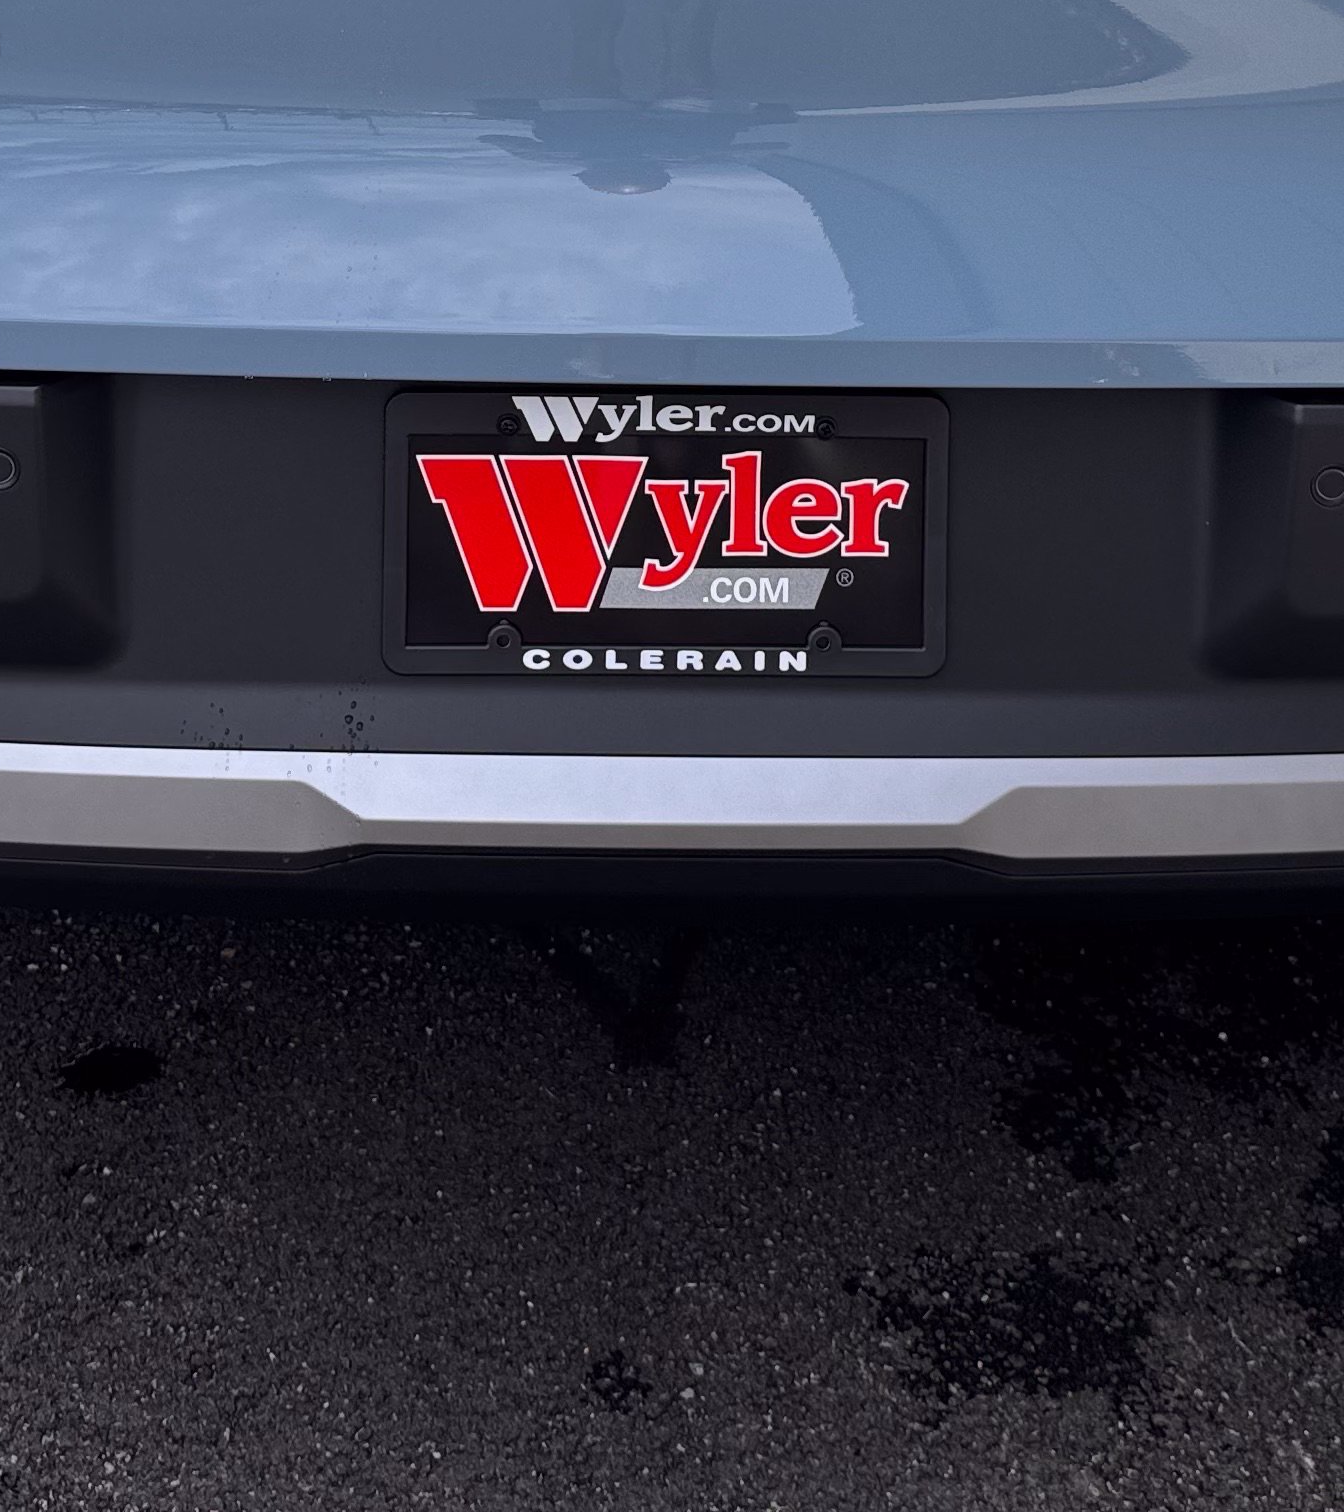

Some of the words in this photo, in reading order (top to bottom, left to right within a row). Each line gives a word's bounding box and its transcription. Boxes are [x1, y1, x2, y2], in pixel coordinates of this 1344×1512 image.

[415, 450, 909, 612] Wyler
[702, 576, 790, 604] .COM
[522, 648, 809, 673] COLERAIN
